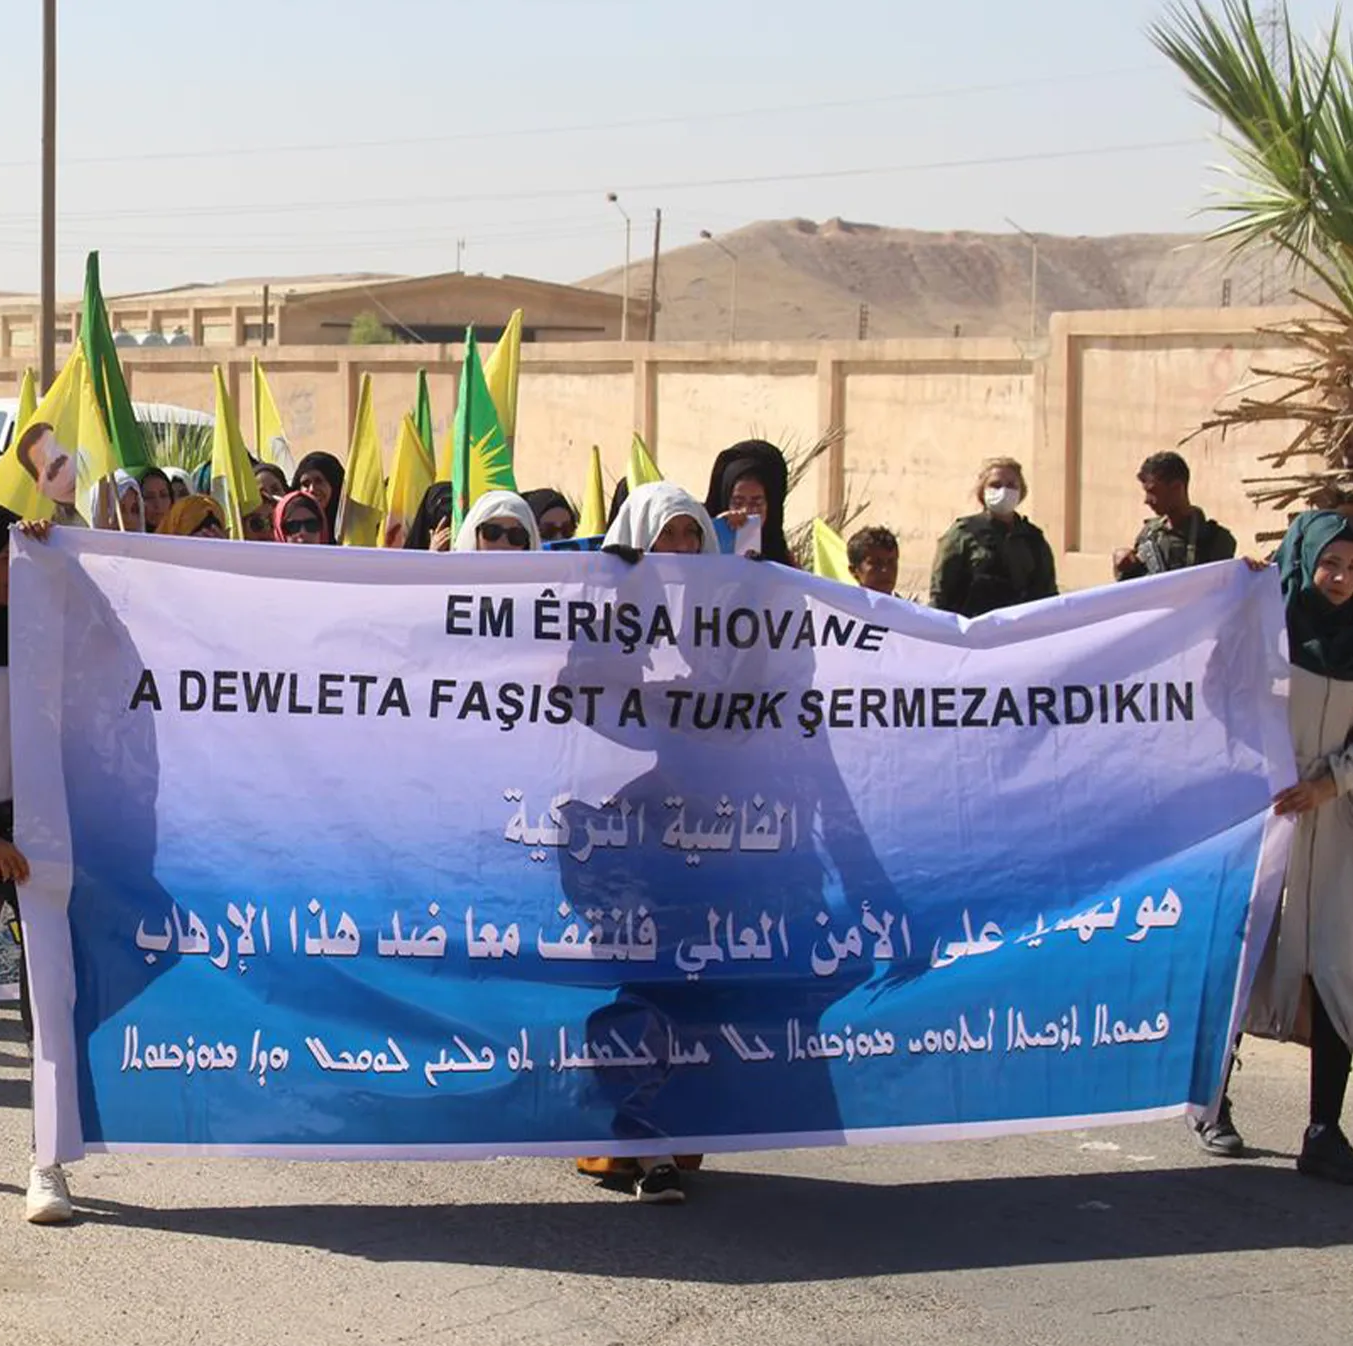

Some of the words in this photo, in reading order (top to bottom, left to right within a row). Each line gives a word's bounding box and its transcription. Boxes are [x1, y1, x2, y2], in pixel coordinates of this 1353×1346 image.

[445, 594, 515, 638] EM
[532, 590, 677, 654] ÊRIŞA
[693, 605, 888, 652] HOVANE
[129, 668, 163, 711] A
[178, 670, 411, 717] DEWLETA
[428, 680, 604, 731] FAŞIST
[618, 688, 648, 728] A
[666, 689, 787, 730] TURK
[796, 682, 1195, 738] ŞERMEZARDIKIN
[135, 901, 271, 974] الإرهاب
[289, 898, 361, 957] هذا
[377, 901, 448, 958] ضد
[464, 905, 521, 959] معا
[537, 901, 658, 960] فلنقف
[810, 900, 912, 977] الأمن
[929, 908, 1005, 969] على
[1125, 888, 1183, 943] هو
